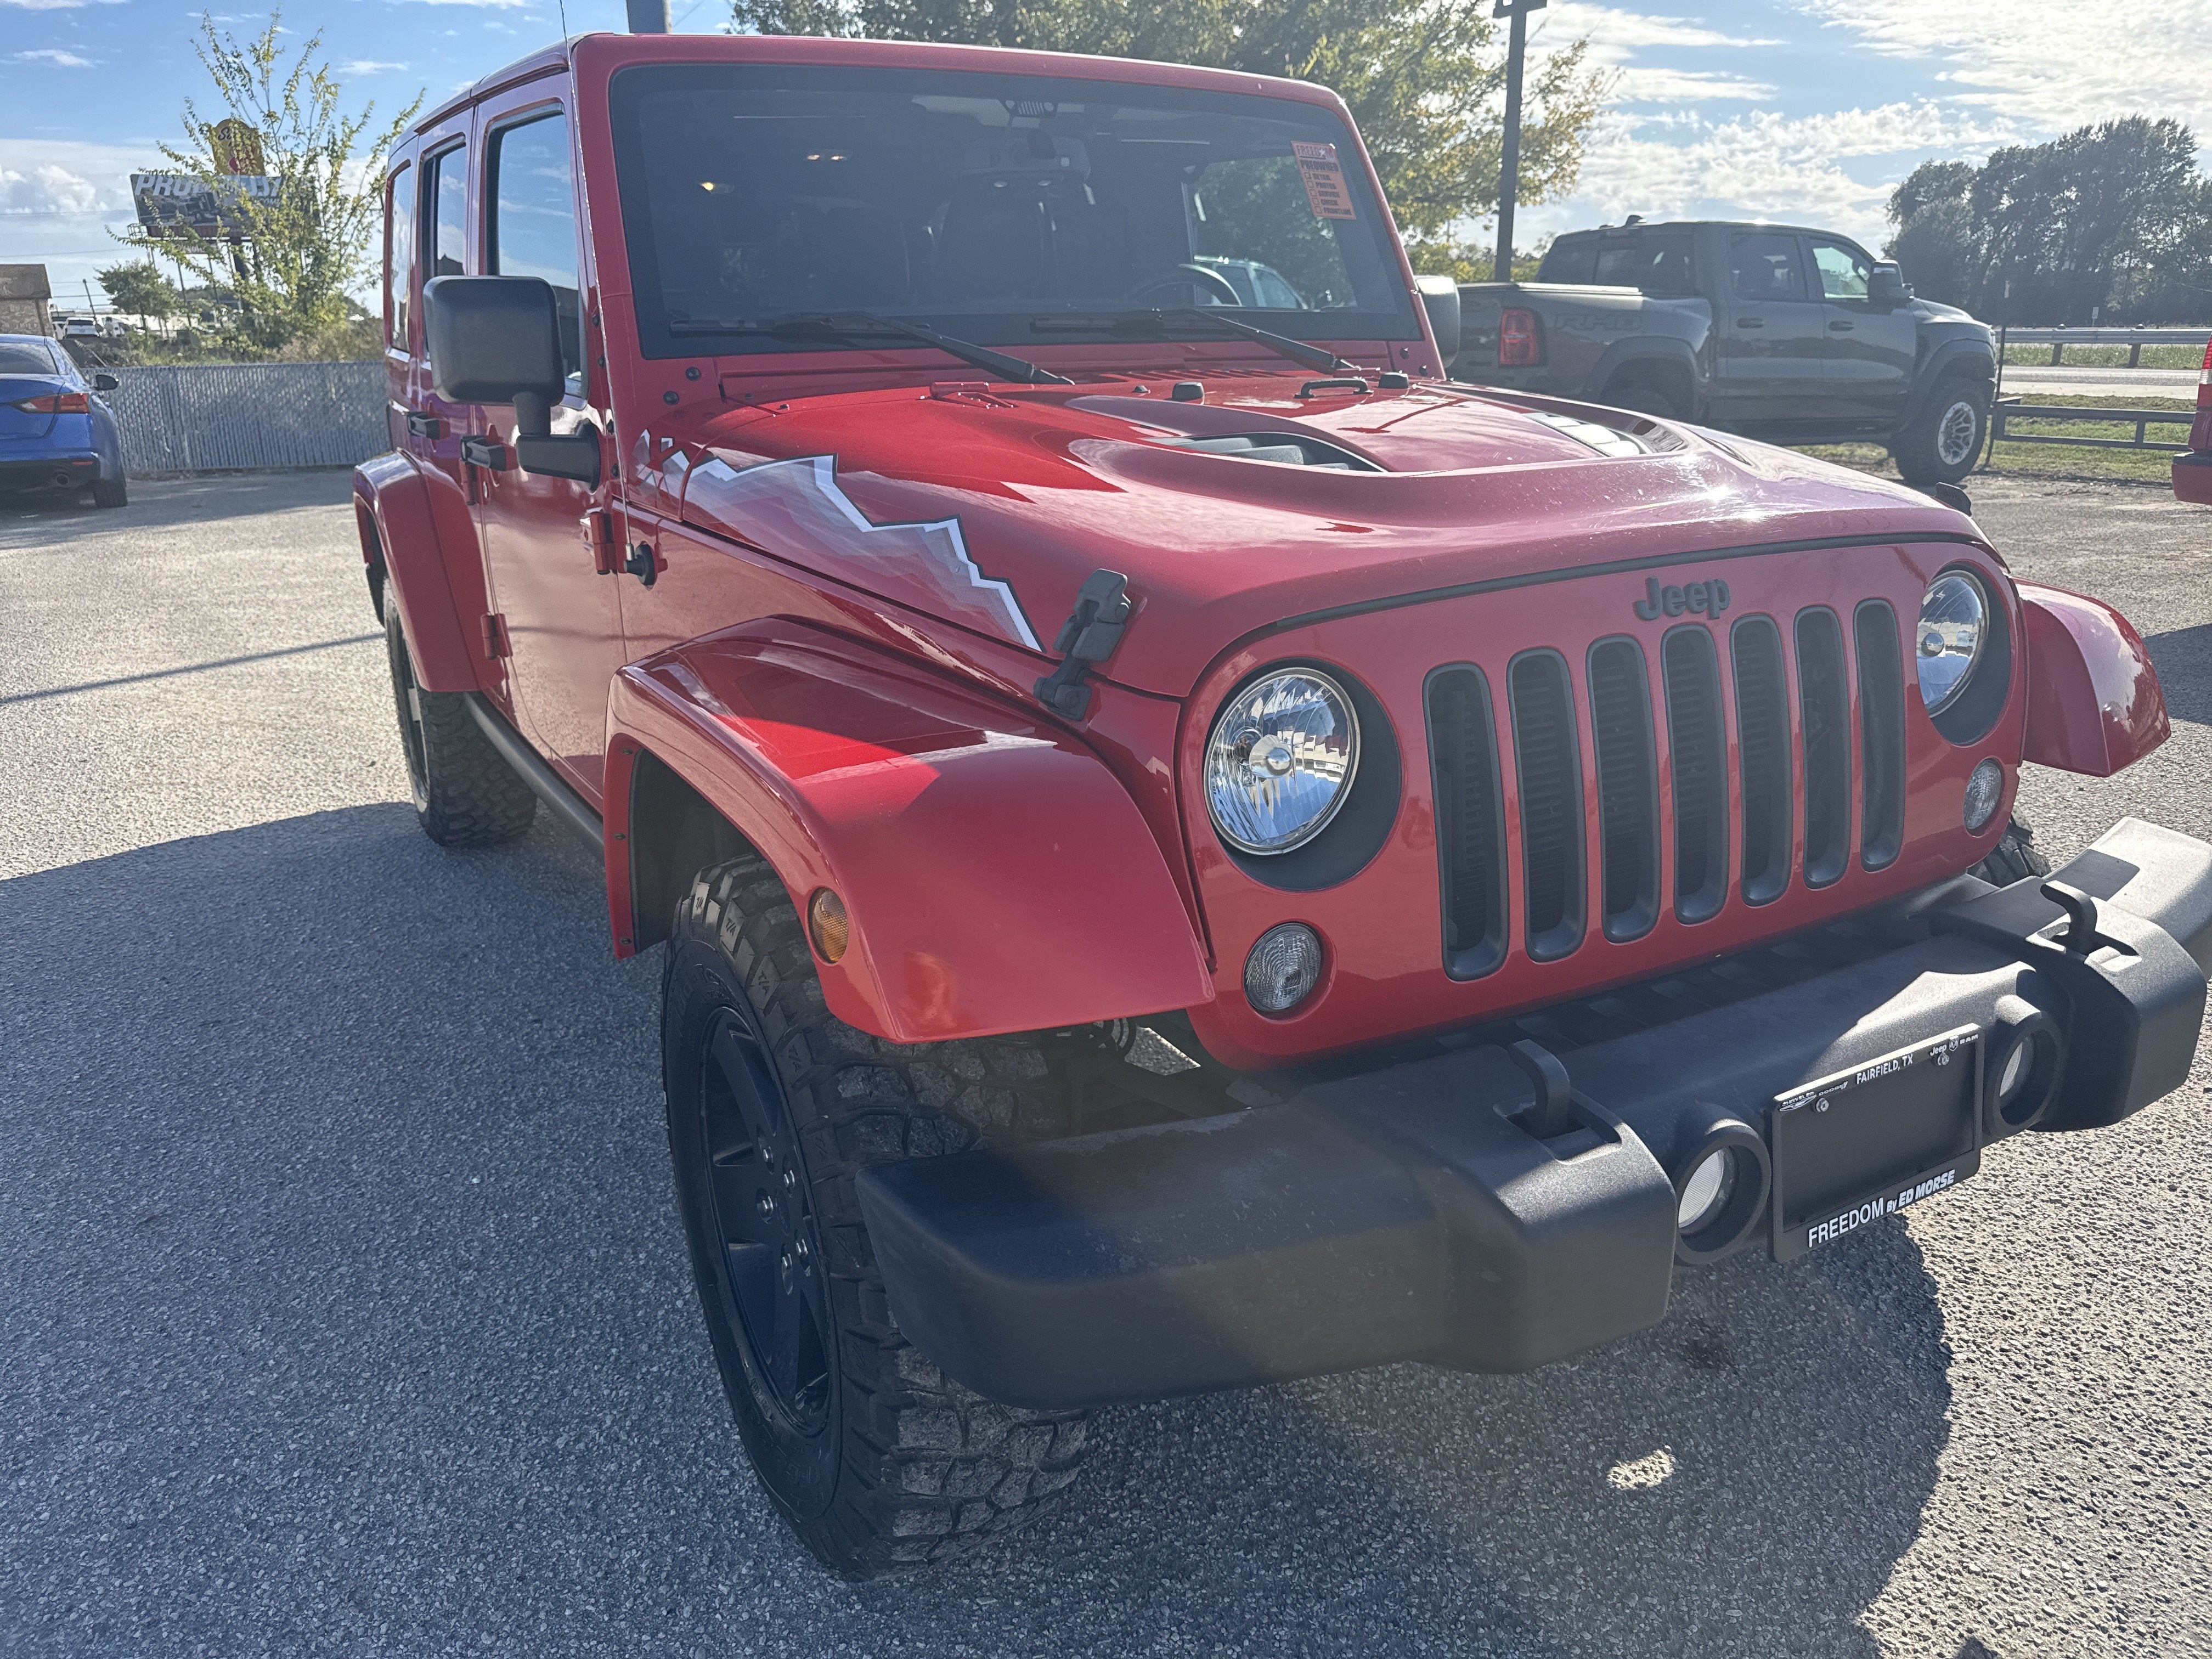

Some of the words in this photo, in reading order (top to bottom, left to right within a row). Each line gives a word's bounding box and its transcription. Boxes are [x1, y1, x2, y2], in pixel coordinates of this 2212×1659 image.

[1633, 576, 1731, 621] Jeep
[1929, 1043, 1948, 1057] Jeep
[1960, 1034, 1979, 1045] RAM
[1856, 1059, 1901, 1084] FAIRFIELD,
[1901, 1053, 1914, 1067] TX
[1781, 1091, 1815, 1107] CHRYSLER
[1808, 1197, 1884, 1248] FREEDOM
[1898, 1187, 1914, 1207] ED
[1915, 1169, 1956, 1200] MORSE
